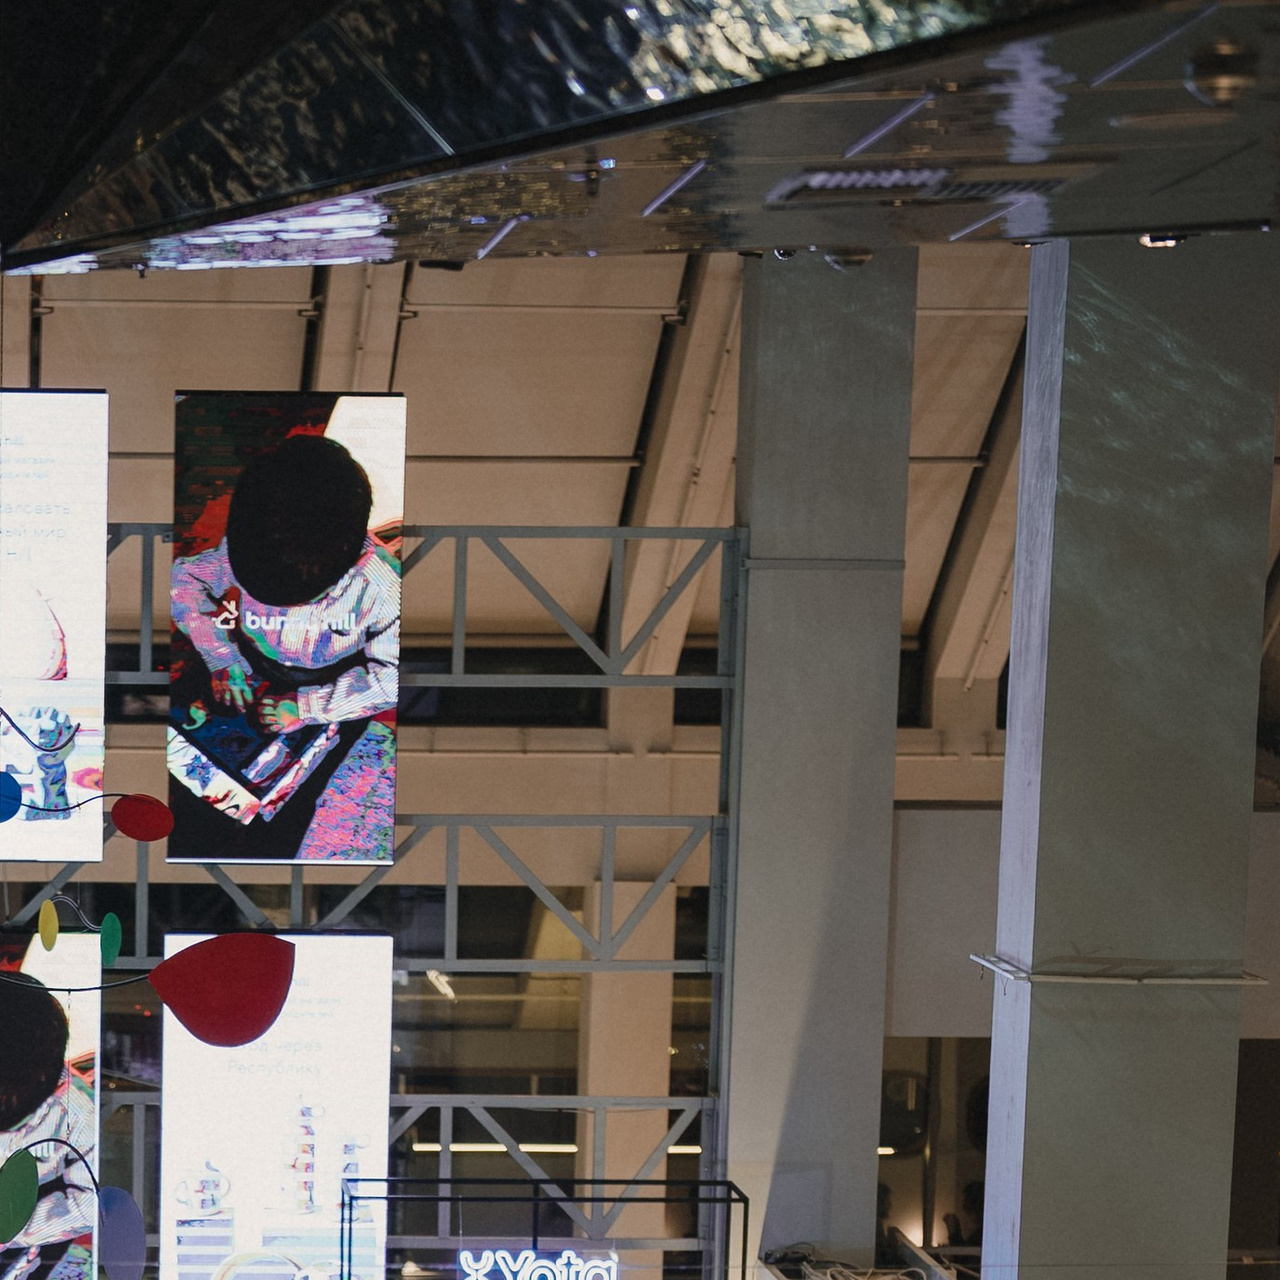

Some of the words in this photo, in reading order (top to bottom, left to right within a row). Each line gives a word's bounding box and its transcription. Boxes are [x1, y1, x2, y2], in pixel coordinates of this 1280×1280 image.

[34, 527, 67, 541] мир
[6, 546, 32, 561] Hill
[274, 1041, 322, 1055] через
[228, 1059, 322, 1078] Республику
